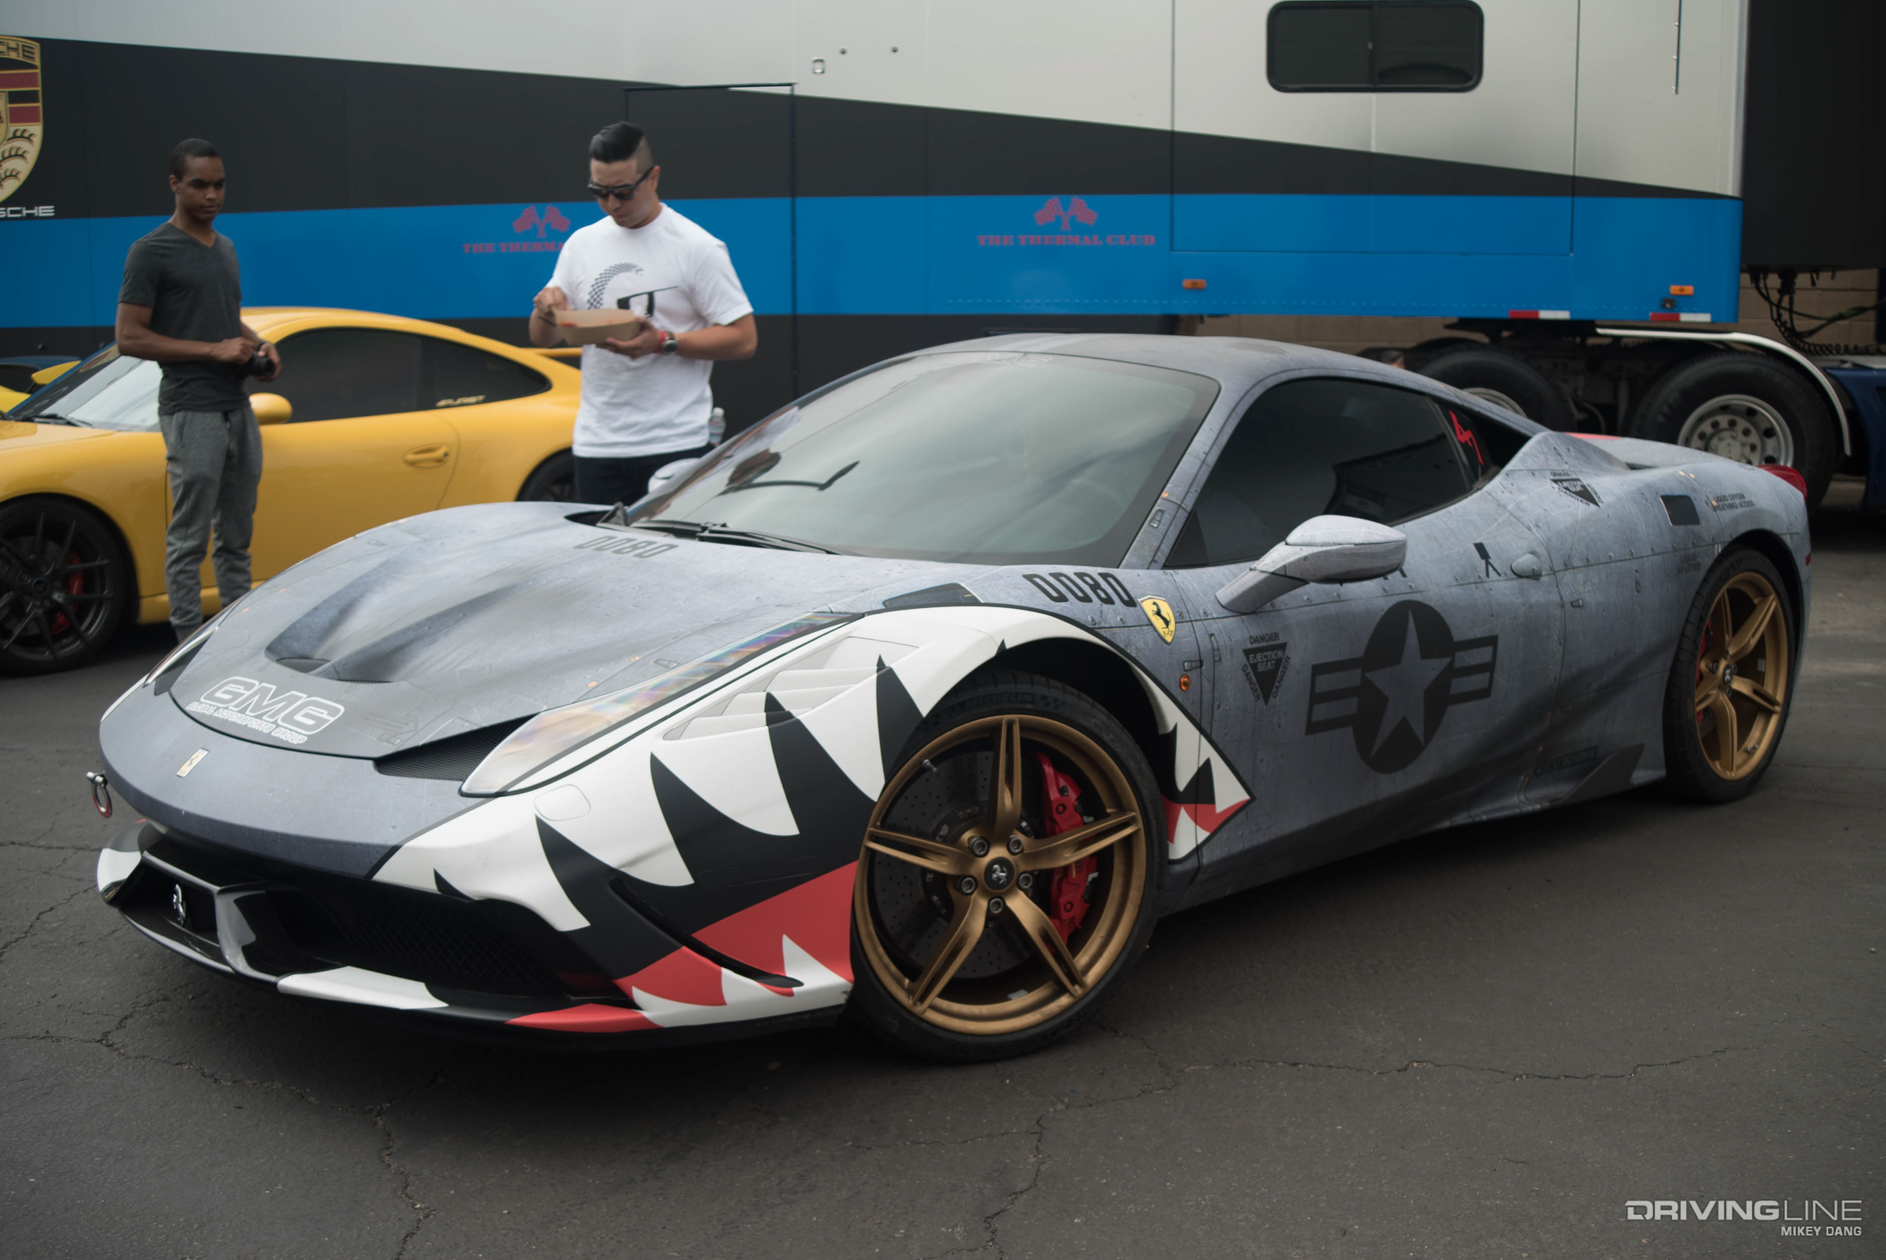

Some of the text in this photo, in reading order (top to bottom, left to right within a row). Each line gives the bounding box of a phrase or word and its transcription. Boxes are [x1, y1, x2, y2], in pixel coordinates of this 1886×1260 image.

[462, 242, 496, 254] THE
[976, 234, 1157, 246] THE THERMAL CLUB
[1022, 571, 1138, 608] 0080
[1249, 632, 1279, 644] DANGER
[1249, 650, 1283, 663] EJECTION
[1258, 660, 1275, 672] SEAT
[1241, 663, 1262, 702] DANGER
[1271, 655, 1291, 699] DANGER
[200, 676, 345, 735] GMG
[270, 726, 309, 745] GROUP
